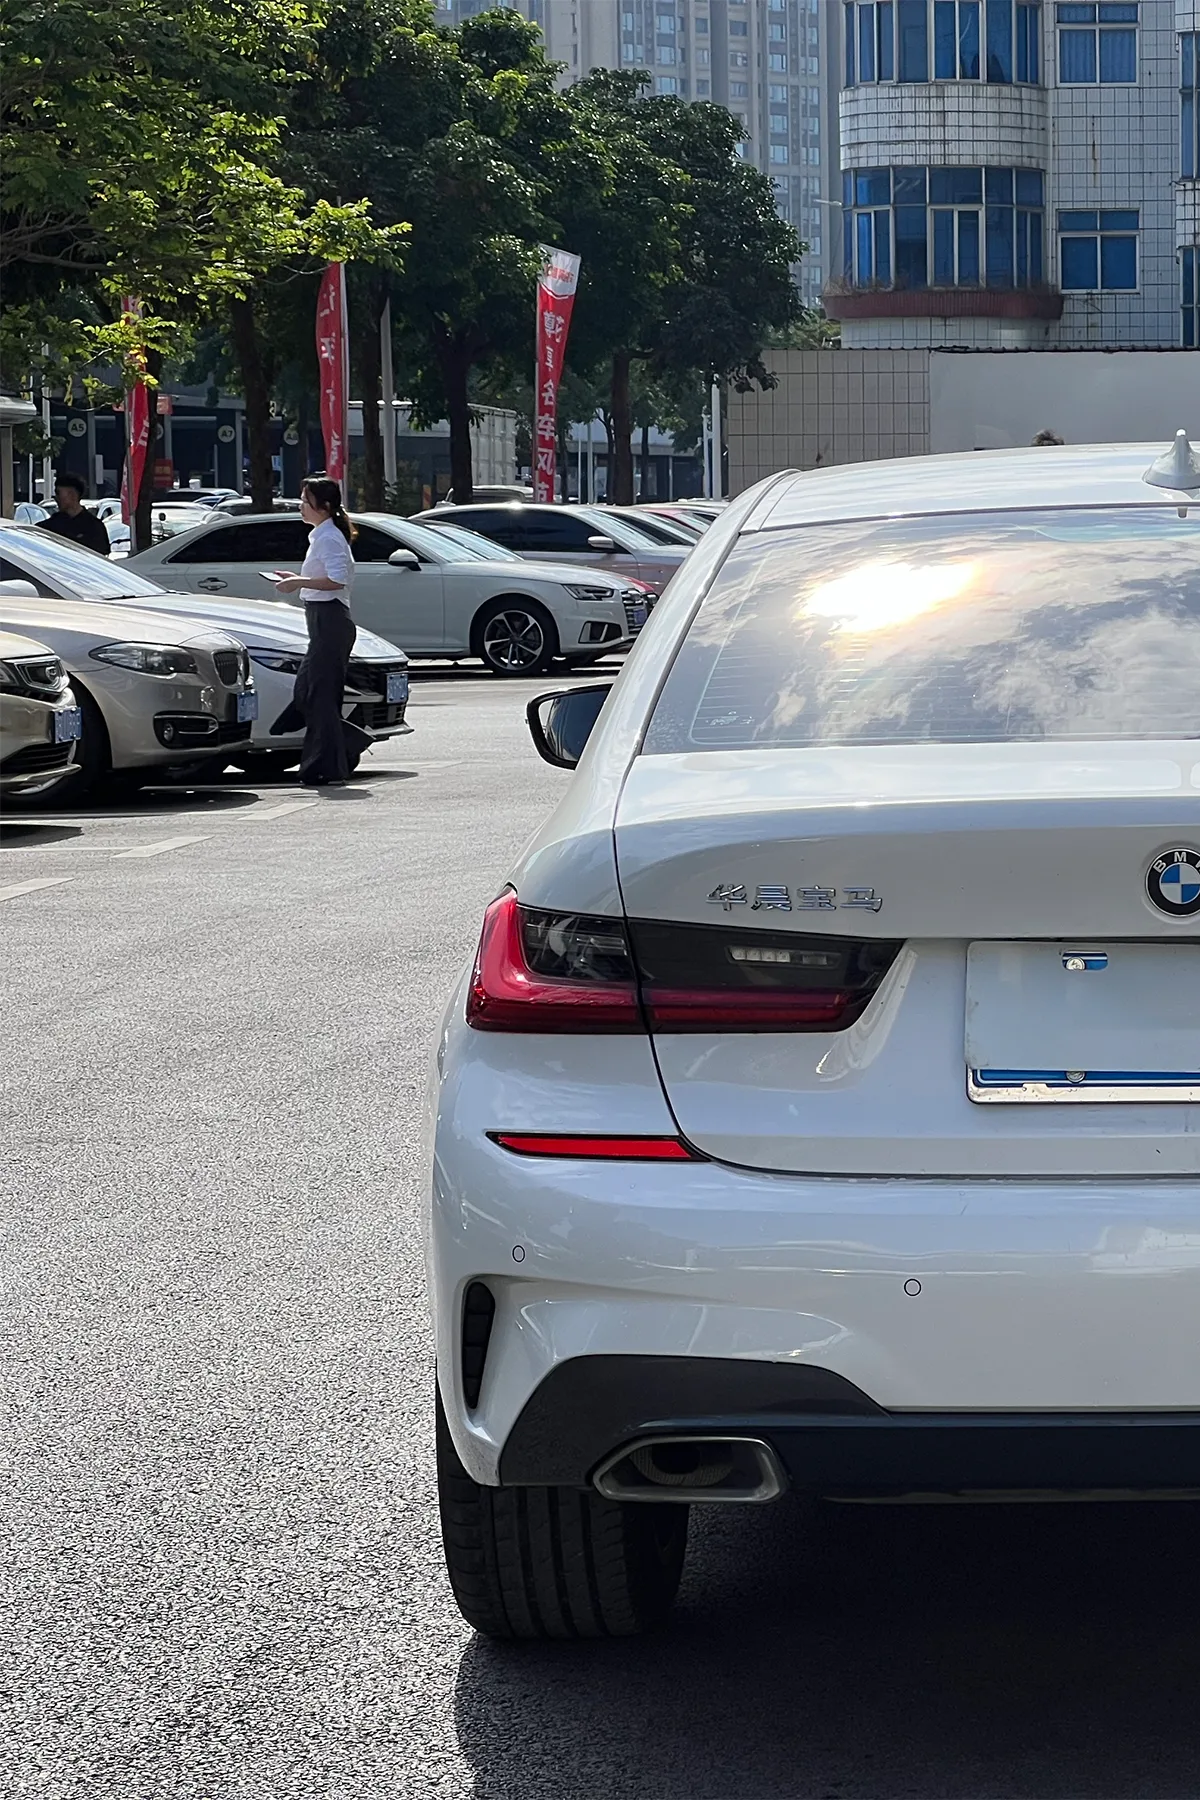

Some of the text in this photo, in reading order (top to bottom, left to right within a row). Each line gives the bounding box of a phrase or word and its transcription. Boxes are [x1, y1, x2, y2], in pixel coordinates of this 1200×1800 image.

[70, 422, 85, 433] A5
[221, 429, 234, 439] A7
[705, 884, 883, 913] 华晨宝马
